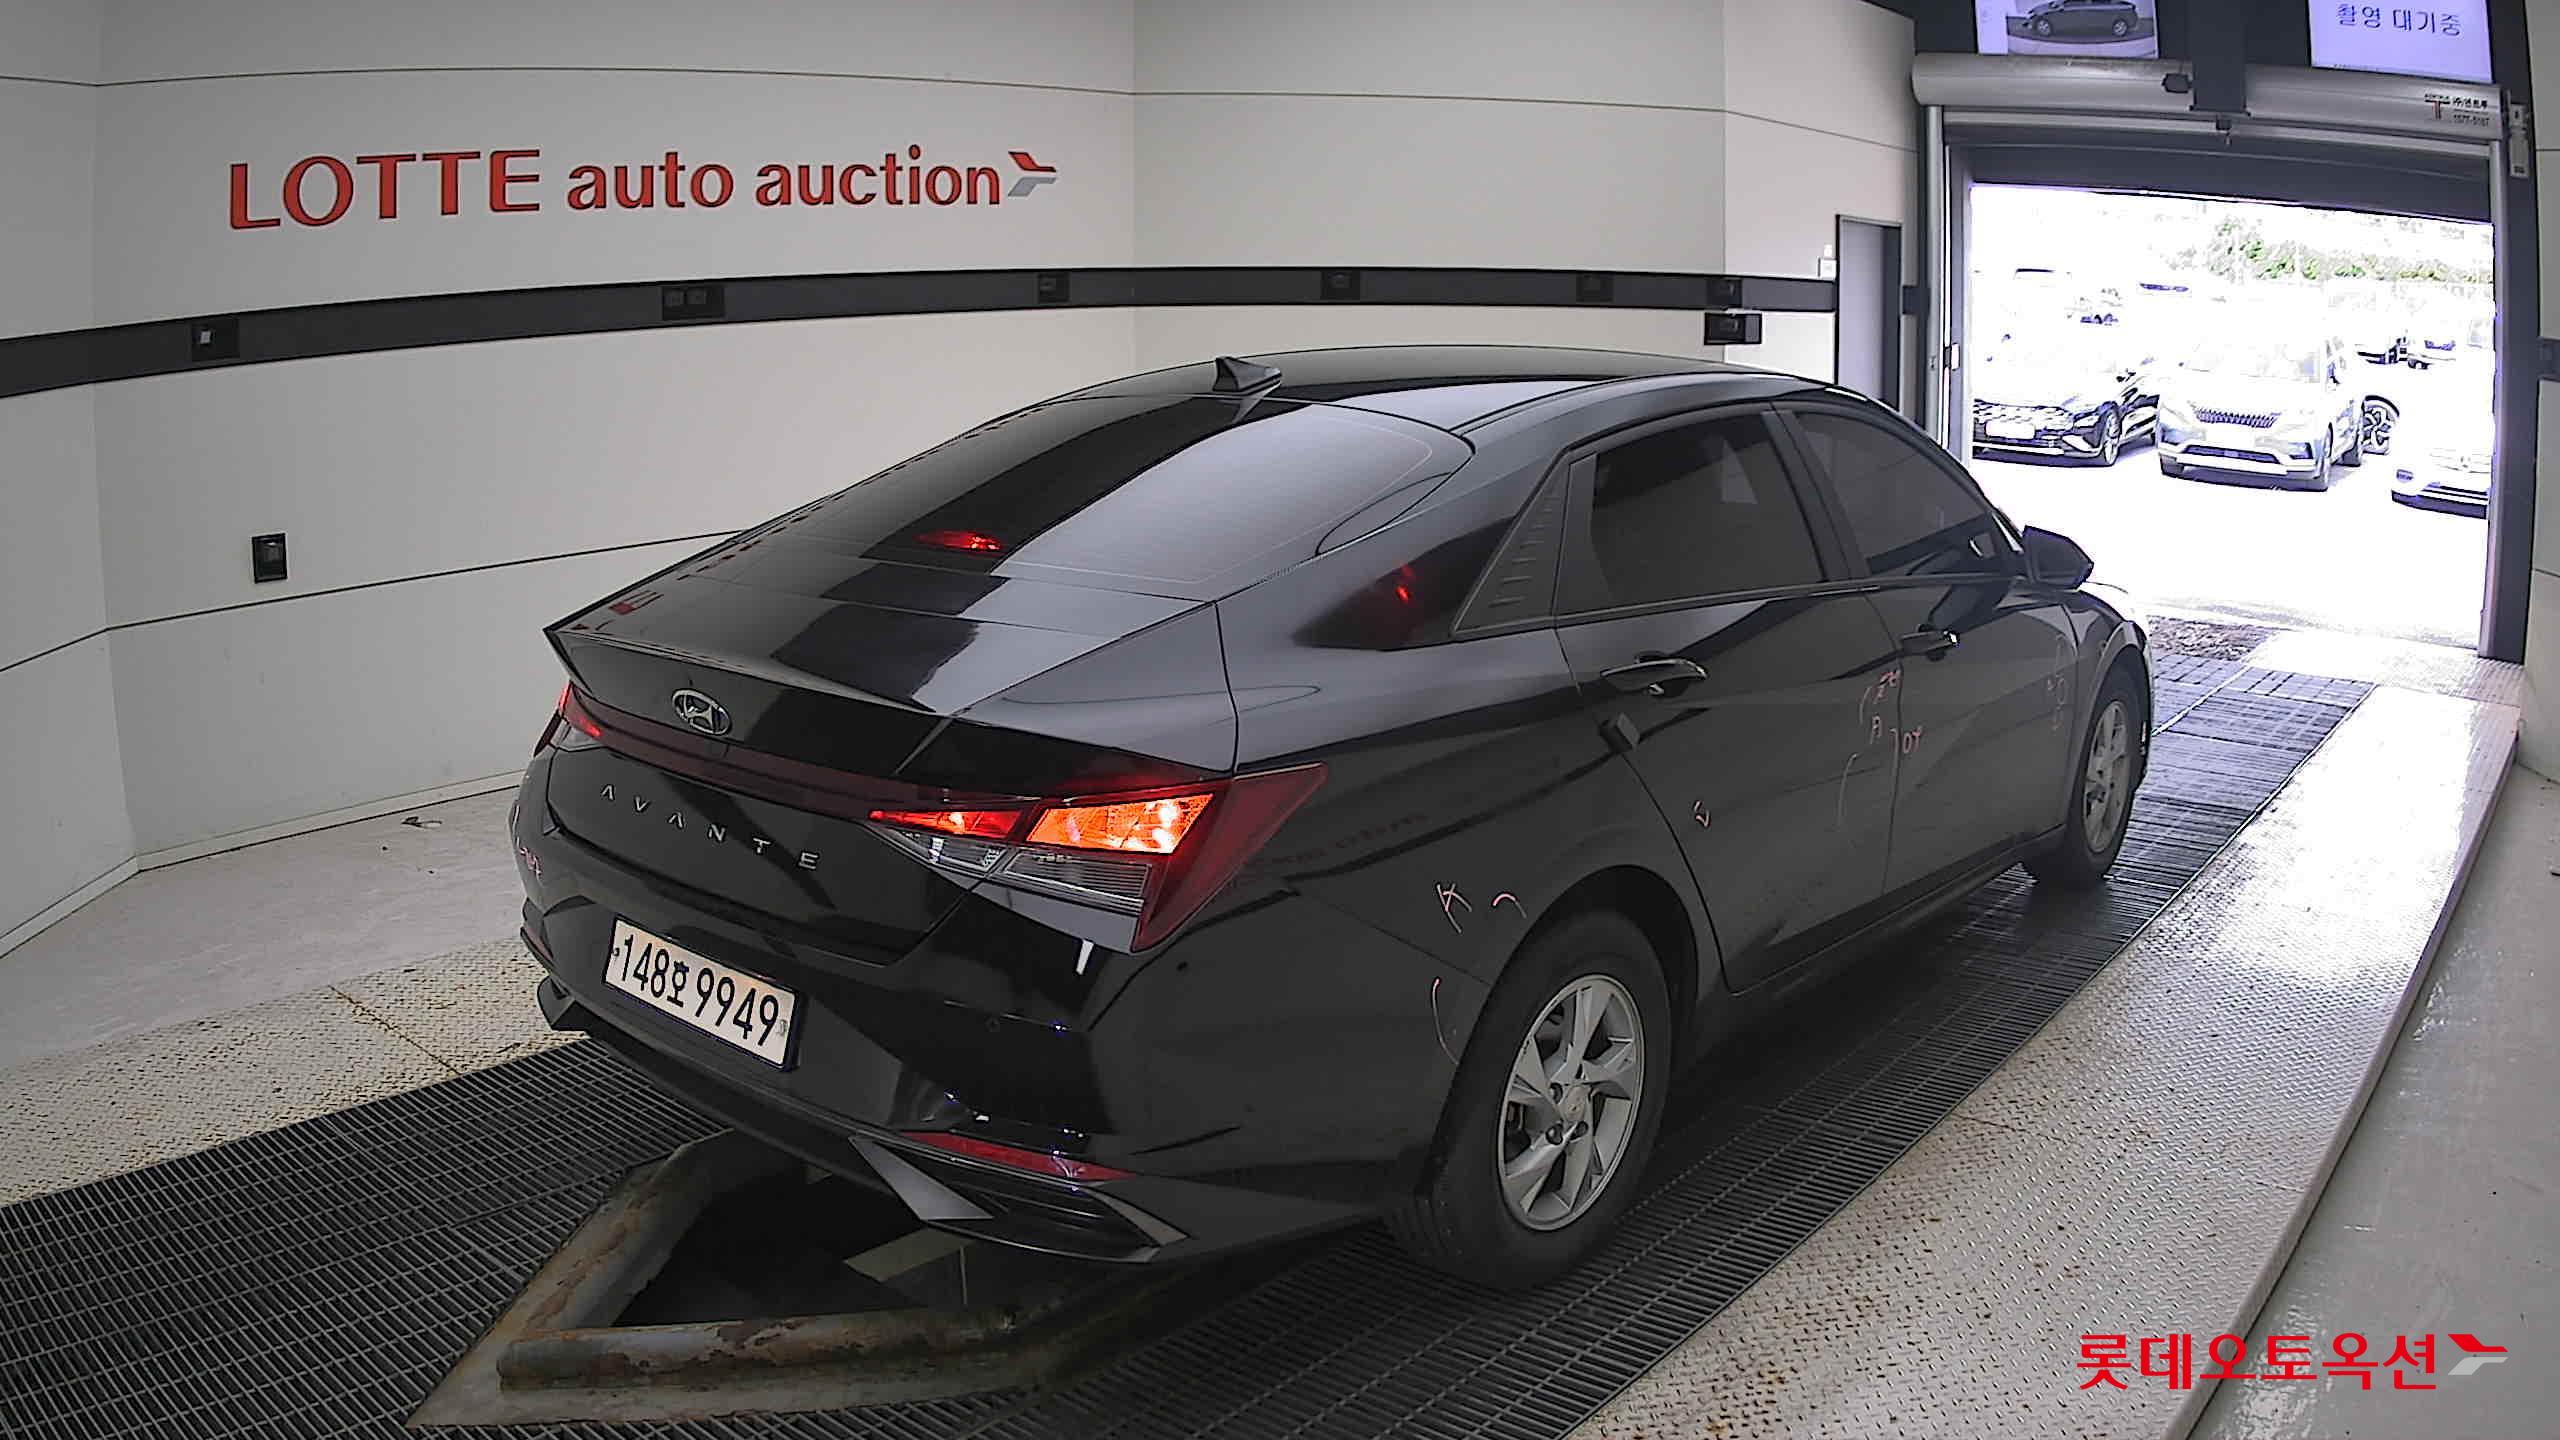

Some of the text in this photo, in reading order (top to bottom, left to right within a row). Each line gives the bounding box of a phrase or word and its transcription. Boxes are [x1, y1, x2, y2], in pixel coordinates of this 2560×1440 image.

[2337, 4, 2461, 37] 촬영 대기중
[228, 145, 1002, 230] LOTTE auto auction
[600, 784, 821, 870] AVANTE
[622, 934, 780, 1047] 148호 9949
